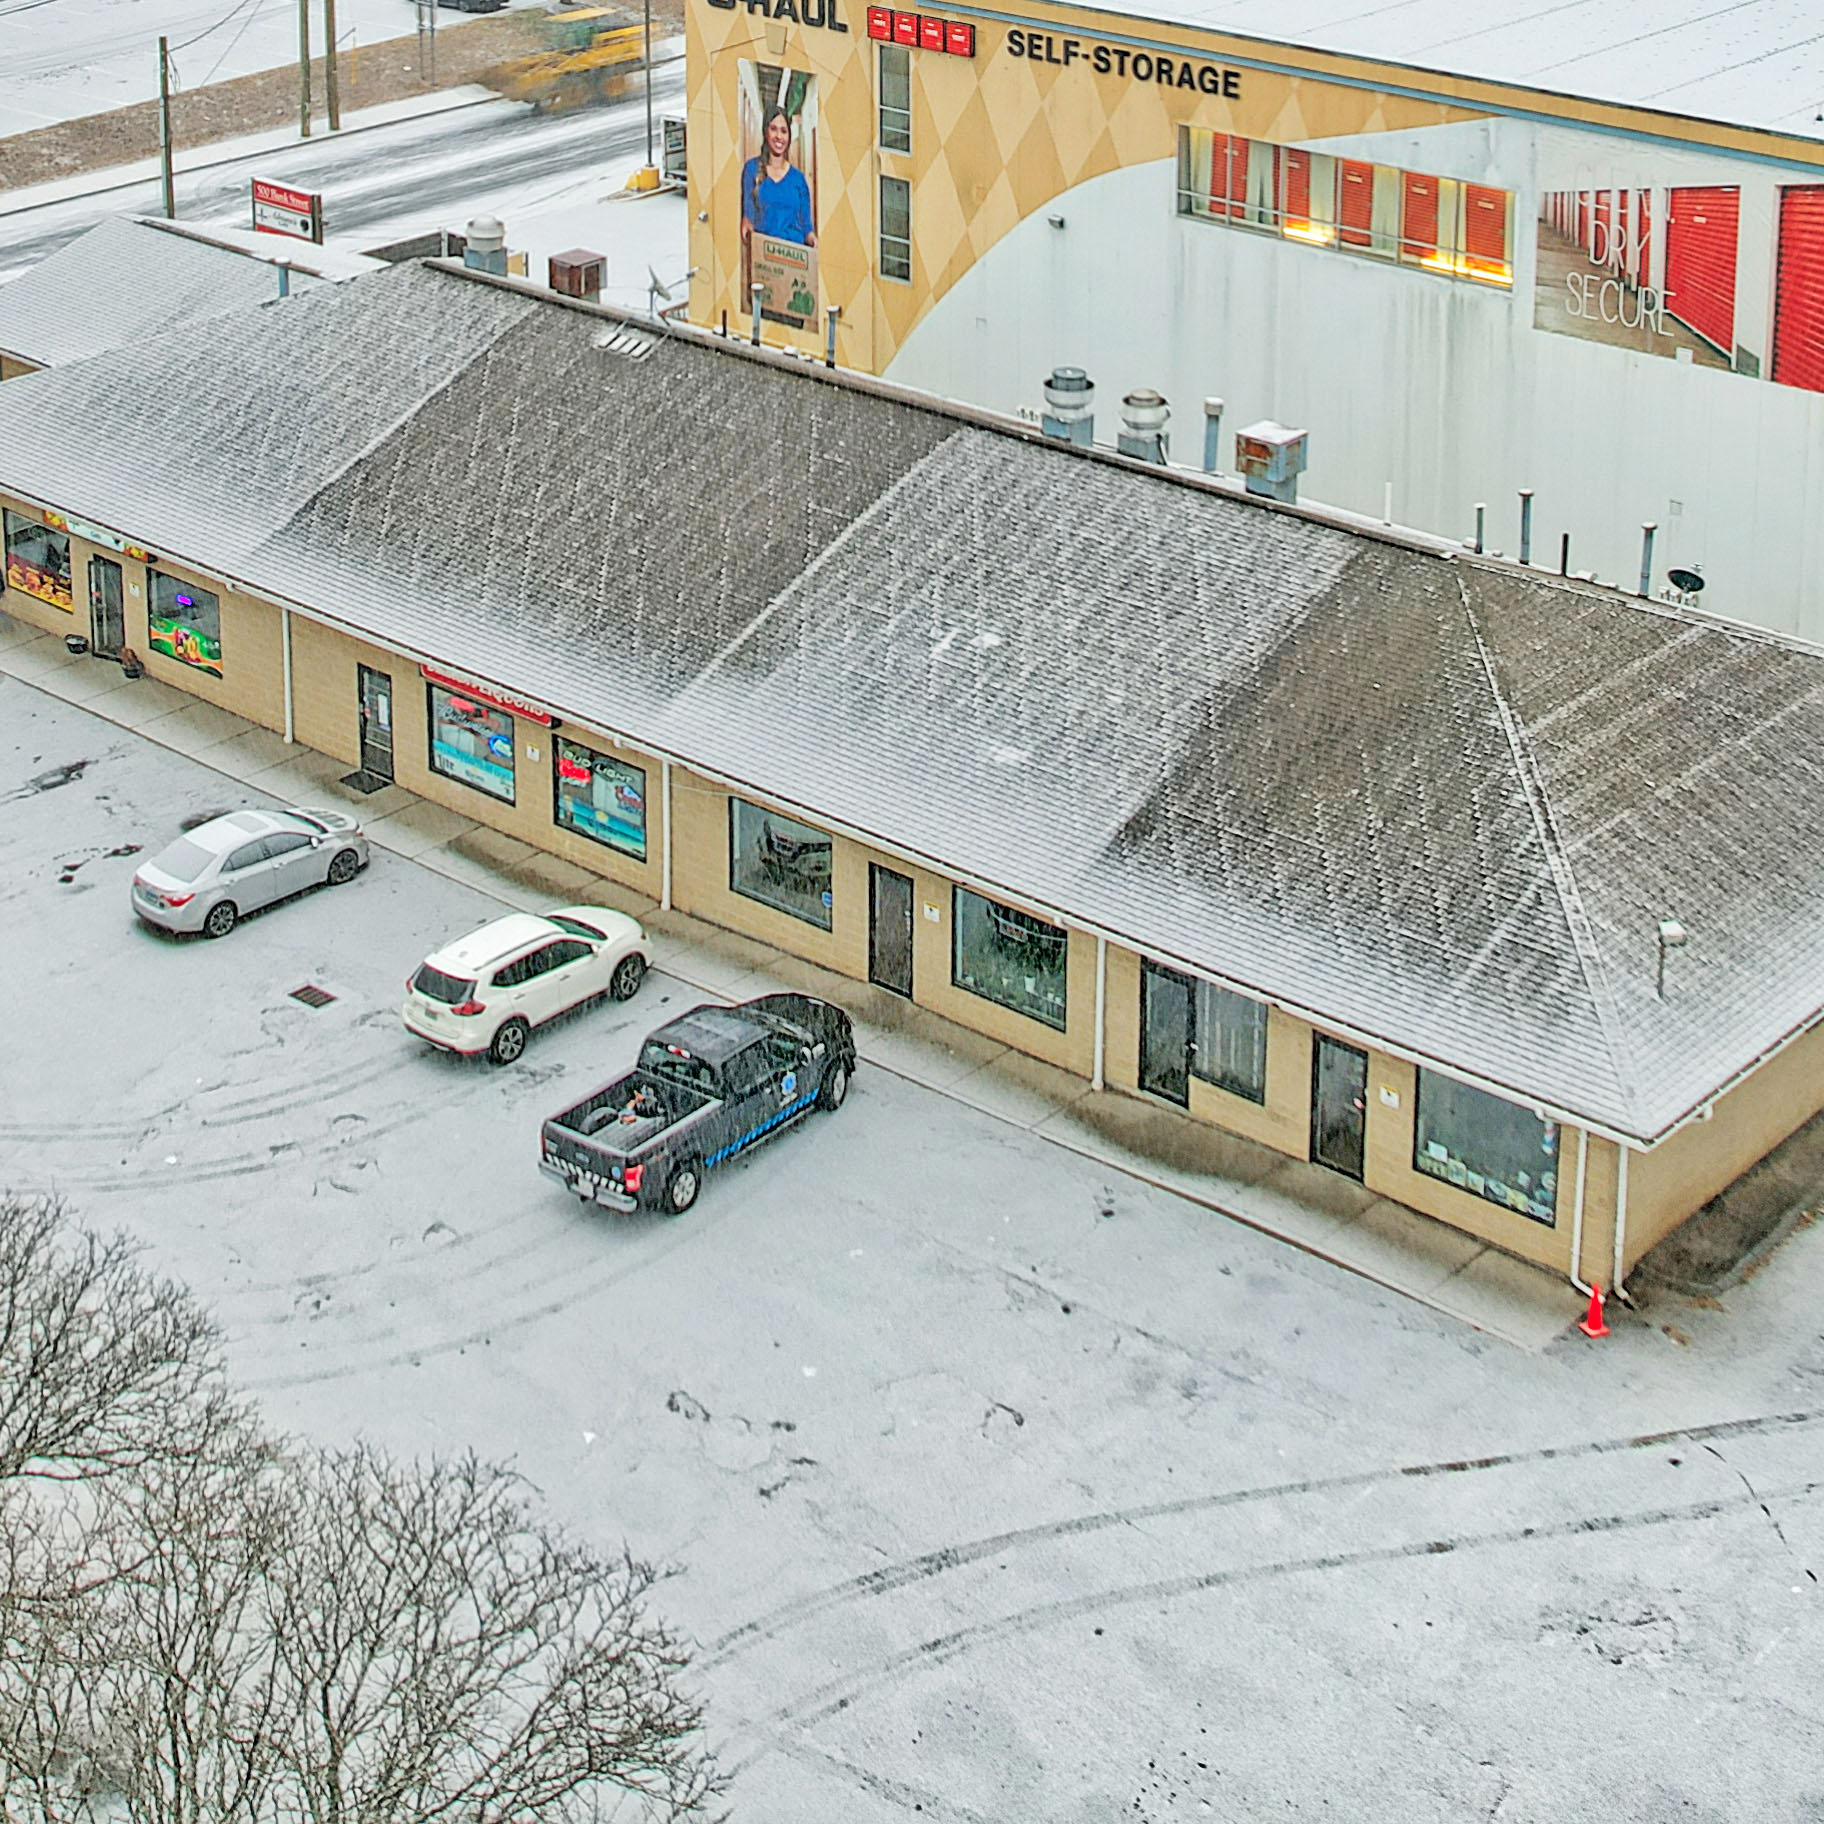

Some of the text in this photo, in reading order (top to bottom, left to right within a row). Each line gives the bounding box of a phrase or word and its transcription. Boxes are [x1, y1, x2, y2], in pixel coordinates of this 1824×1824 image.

[1006, 29, 1242, 100] SELF-STORAGE
[1588, 219, 1651, 274] DRY
[1564, 271, 1677, 337] SECURE
[562, 750, 634, 783] BUD LIGHT
